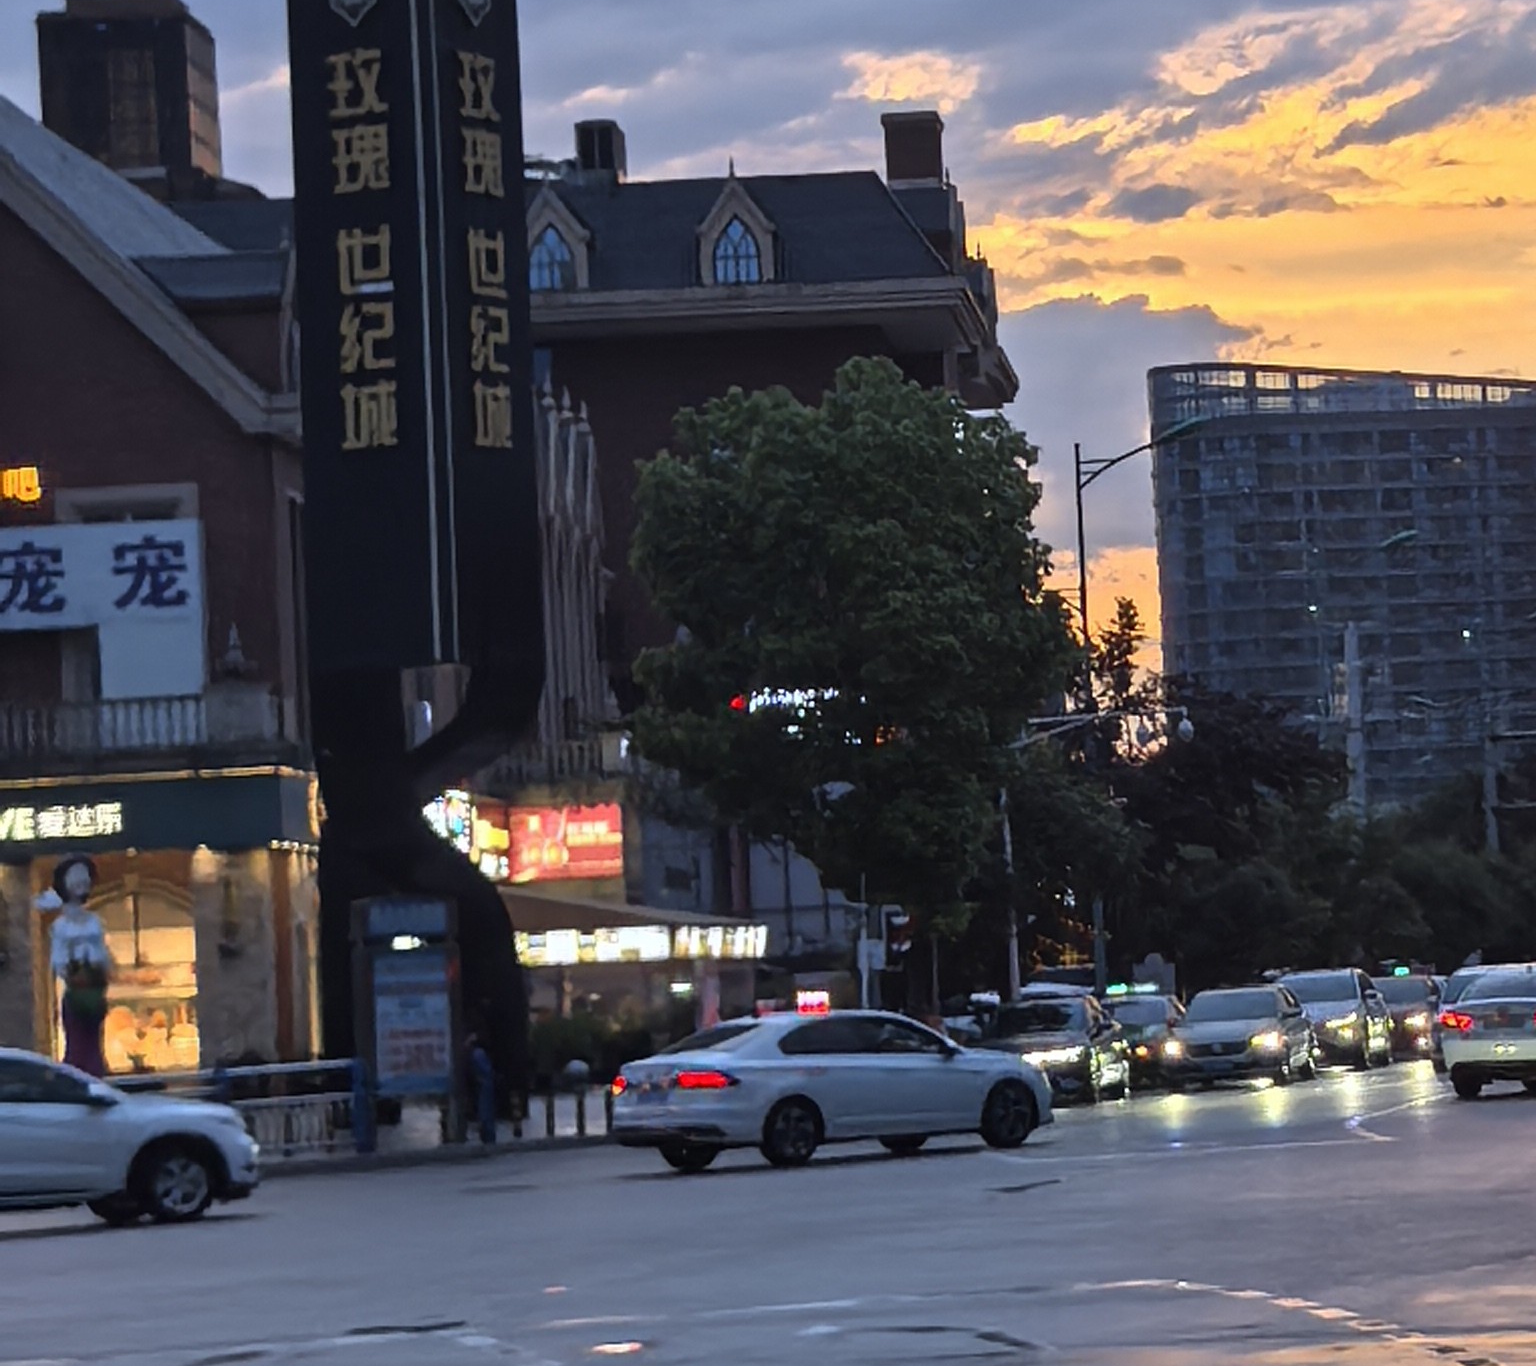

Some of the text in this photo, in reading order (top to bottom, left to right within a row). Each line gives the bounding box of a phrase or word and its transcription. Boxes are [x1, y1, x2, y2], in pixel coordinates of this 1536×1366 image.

[327, 48, 398, 450] 玫瑰世纪城
[458, 51, 513, 449] 玫瑰世纪城
